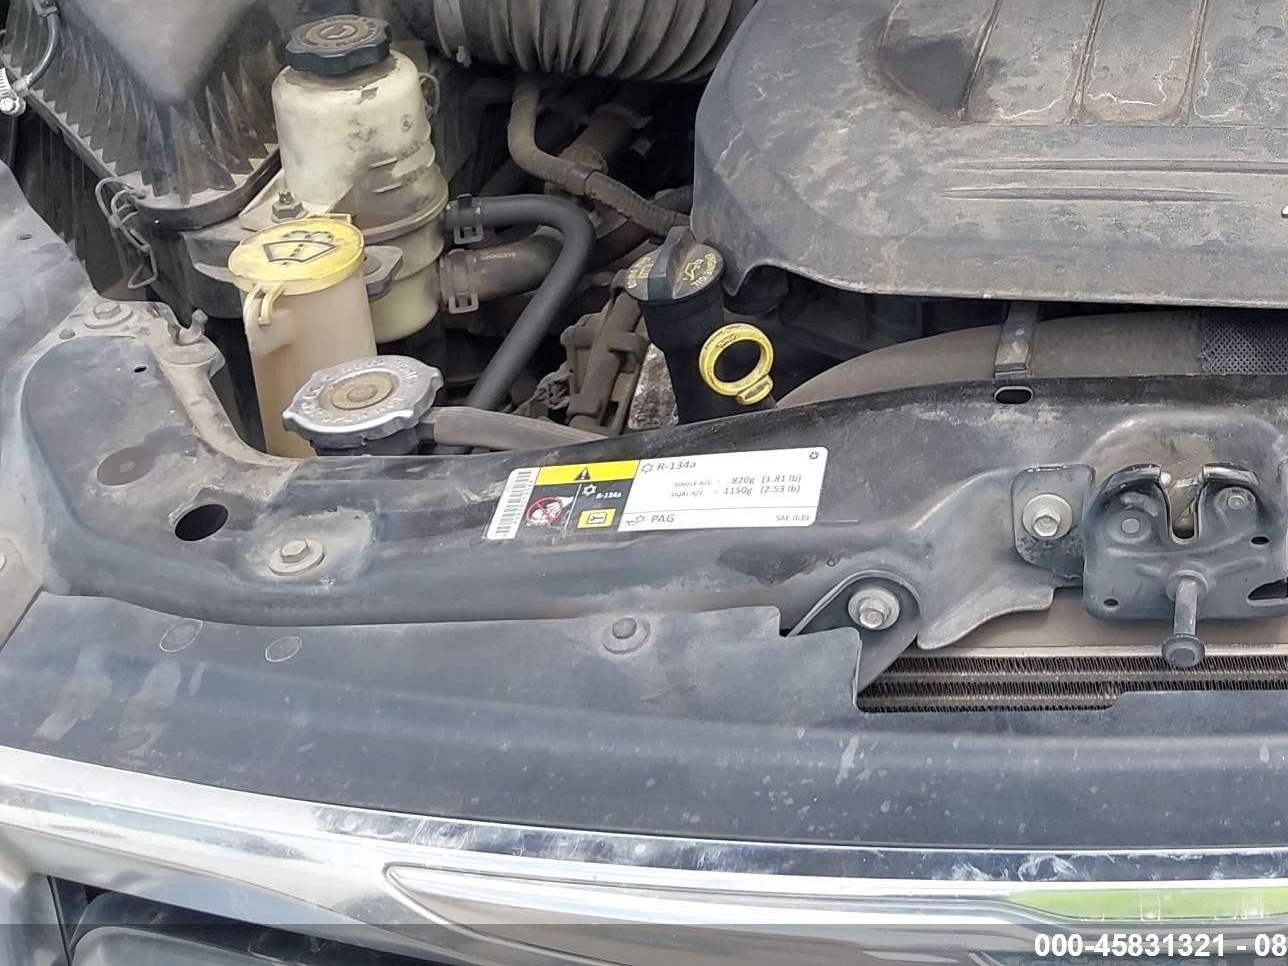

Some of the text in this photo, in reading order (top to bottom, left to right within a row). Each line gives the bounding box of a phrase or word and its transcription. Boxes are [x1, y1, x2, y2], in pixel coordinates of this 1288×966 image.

[656, 460, 697, 471] R-134a
[731, 476, 756, 486] 820g
[723, 486, 753, 496] 1150g
[651, 513, 675, 523] PAG
